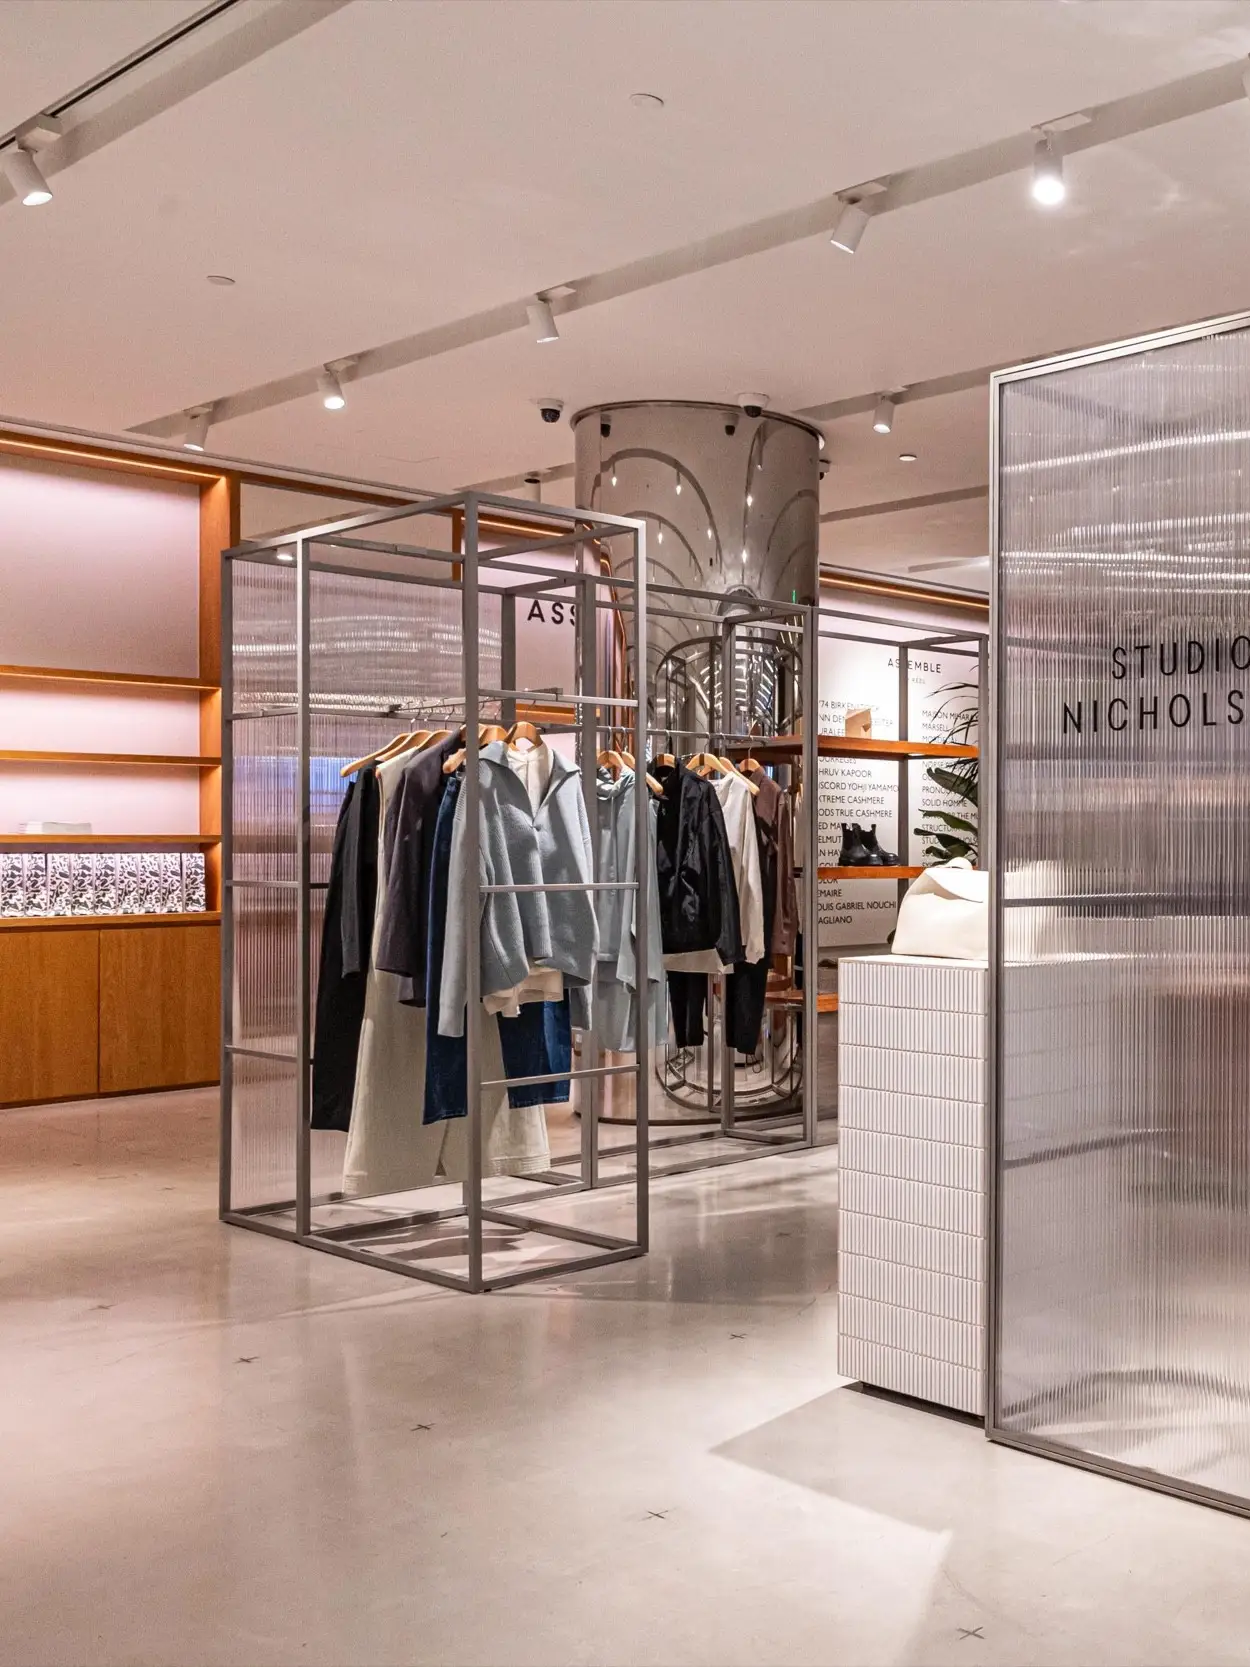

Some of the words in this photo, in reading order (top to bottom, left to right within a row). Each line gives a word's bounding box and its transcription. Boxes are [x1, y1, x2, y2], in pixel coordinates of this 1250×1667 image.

[887, 658, 942, 673] ASEMBLE
[840, 769, 873, 779] KAPOOR
[847, 795, 885, 805] CASHMERE
[835, 808, 854, 818] TRUE
[855, 809, 893, 819] CASHMERE
[835, 901, 865, 911] GABRIEL
[866, 900, 897, 910] NOUCHI
